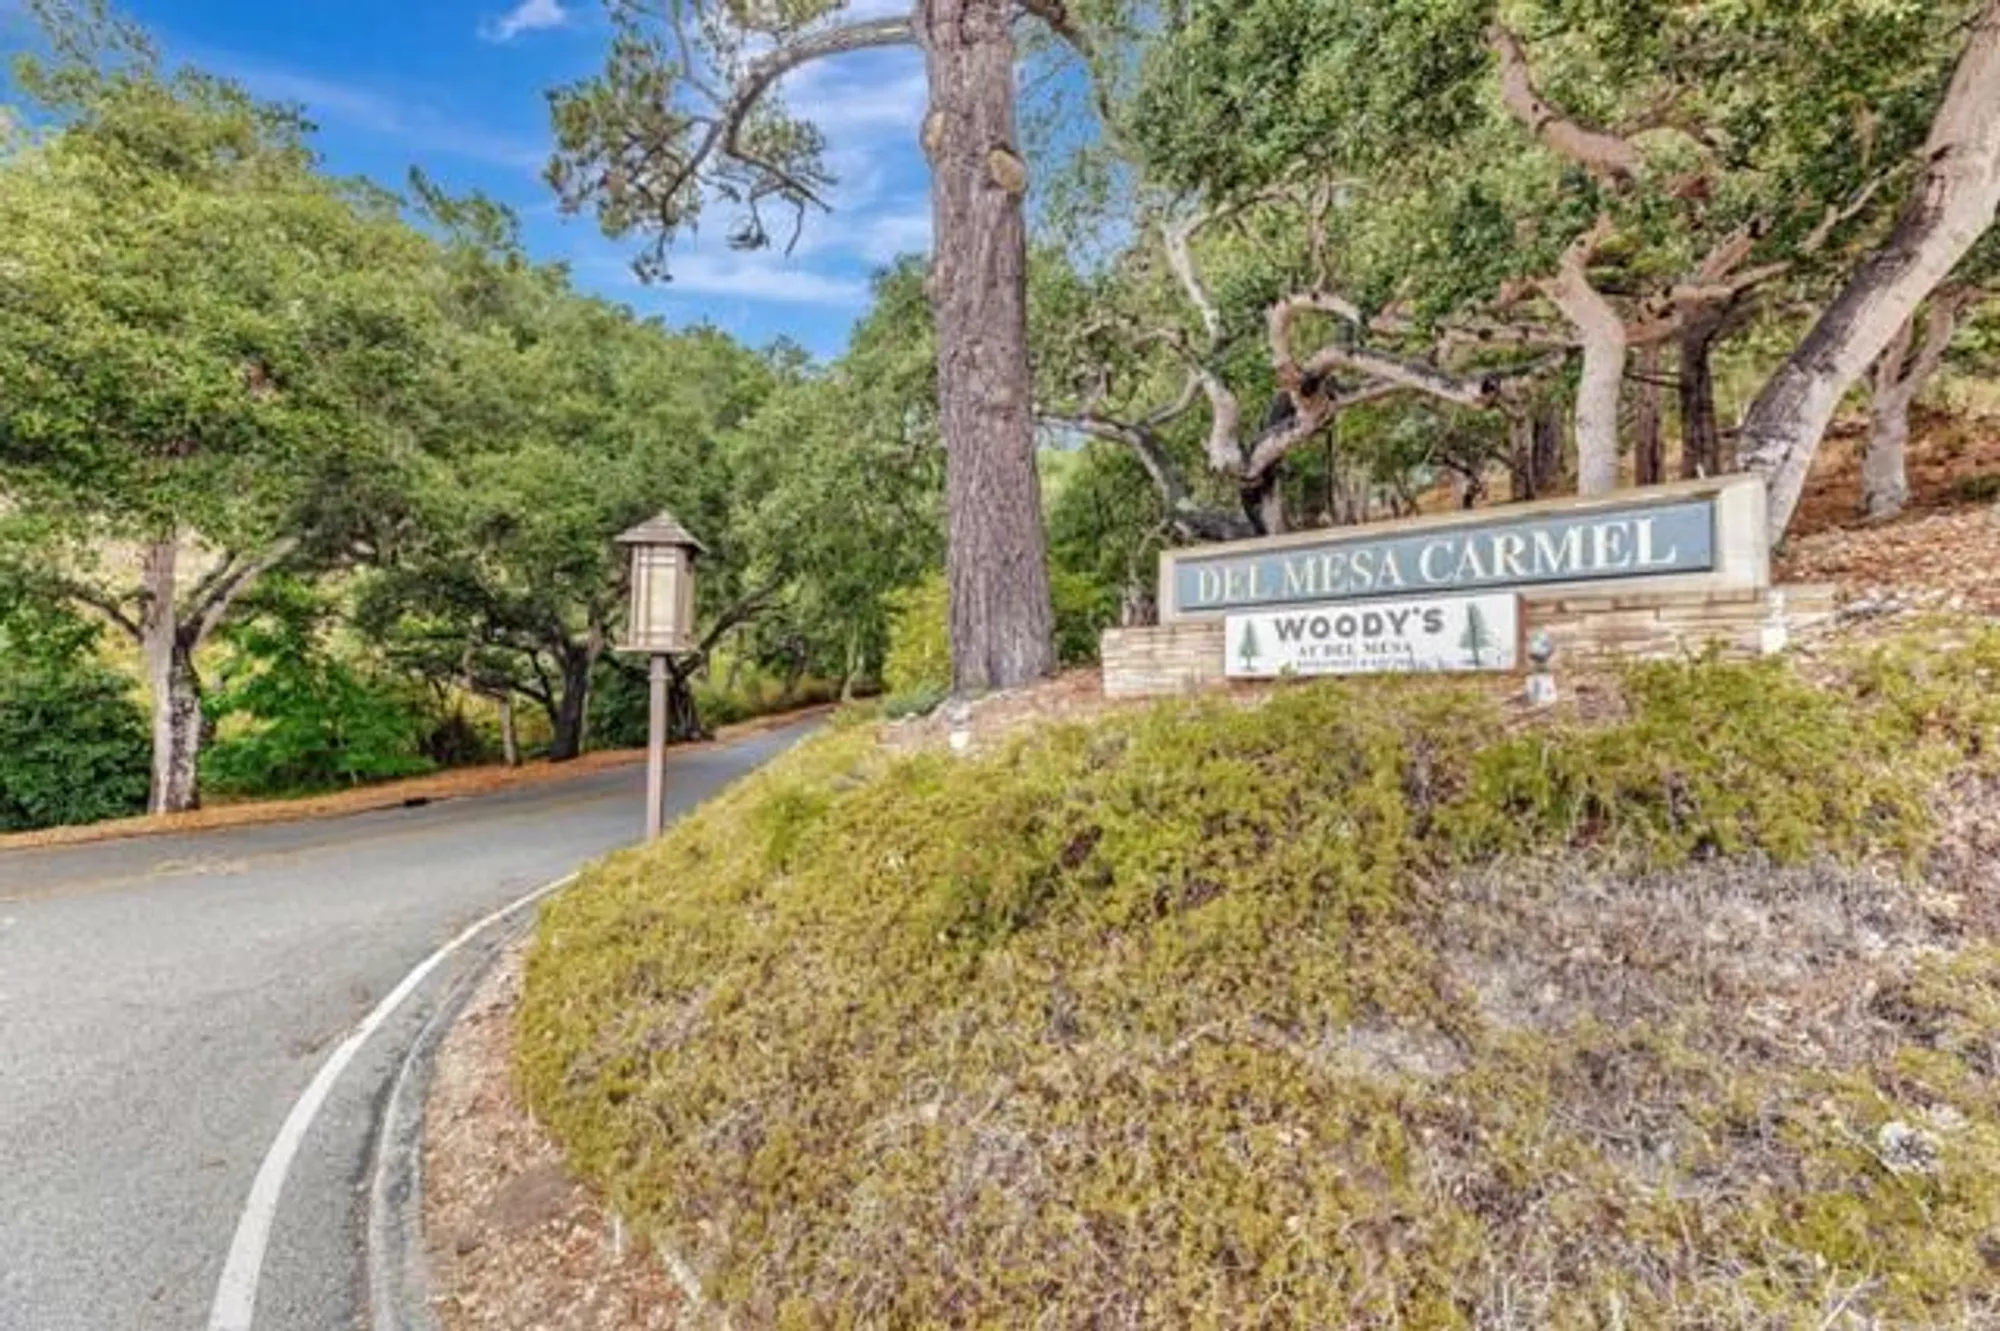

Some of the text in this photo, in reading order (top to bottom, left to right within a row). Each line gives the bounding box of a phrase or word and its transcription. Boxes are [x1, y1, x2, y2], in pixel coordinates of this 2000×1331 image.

[1199, 517, 1677, 602] DEL MESA CARMEL
[1275, 607, 1444, 642] WOODY'S
